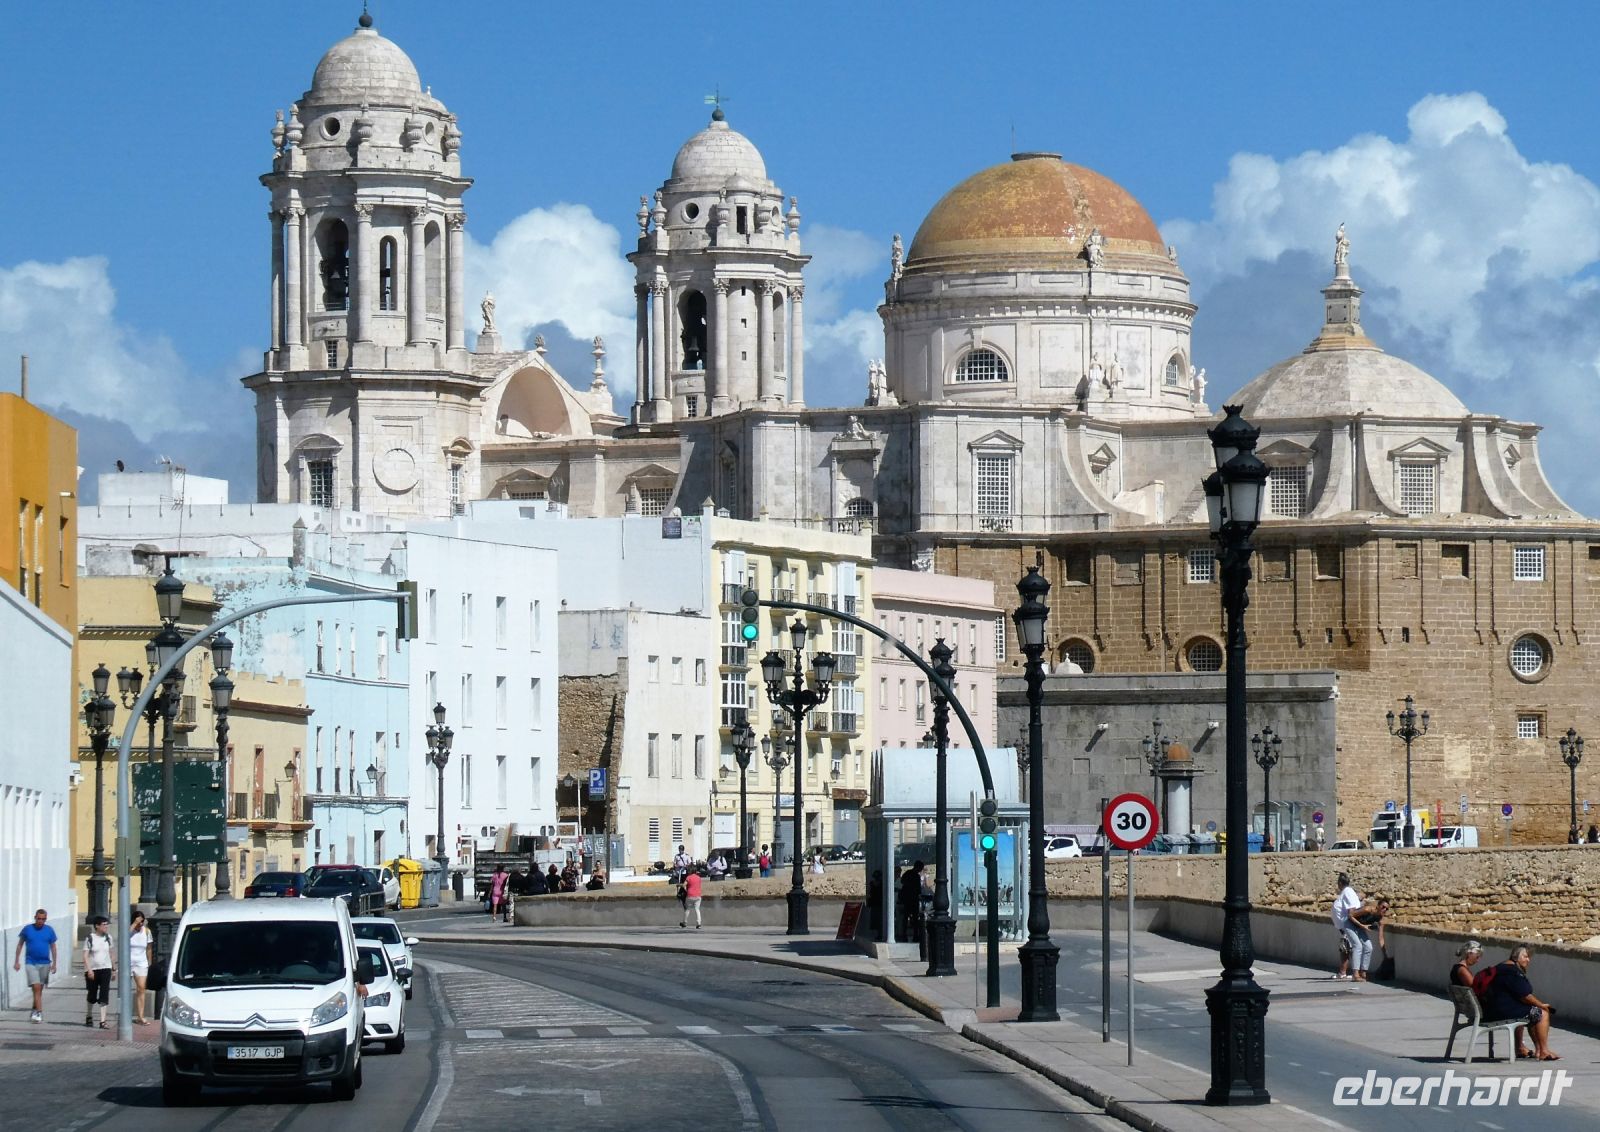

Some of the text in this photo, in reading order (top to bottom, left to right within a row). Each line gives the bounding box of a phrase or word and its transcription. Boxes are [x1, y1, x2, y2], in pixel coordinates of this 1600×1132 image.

[590, 769, 601, 787] P
[1116, 812, 1147, 830] 30
[235, 1047, 282, 1058] 3517 GJP
